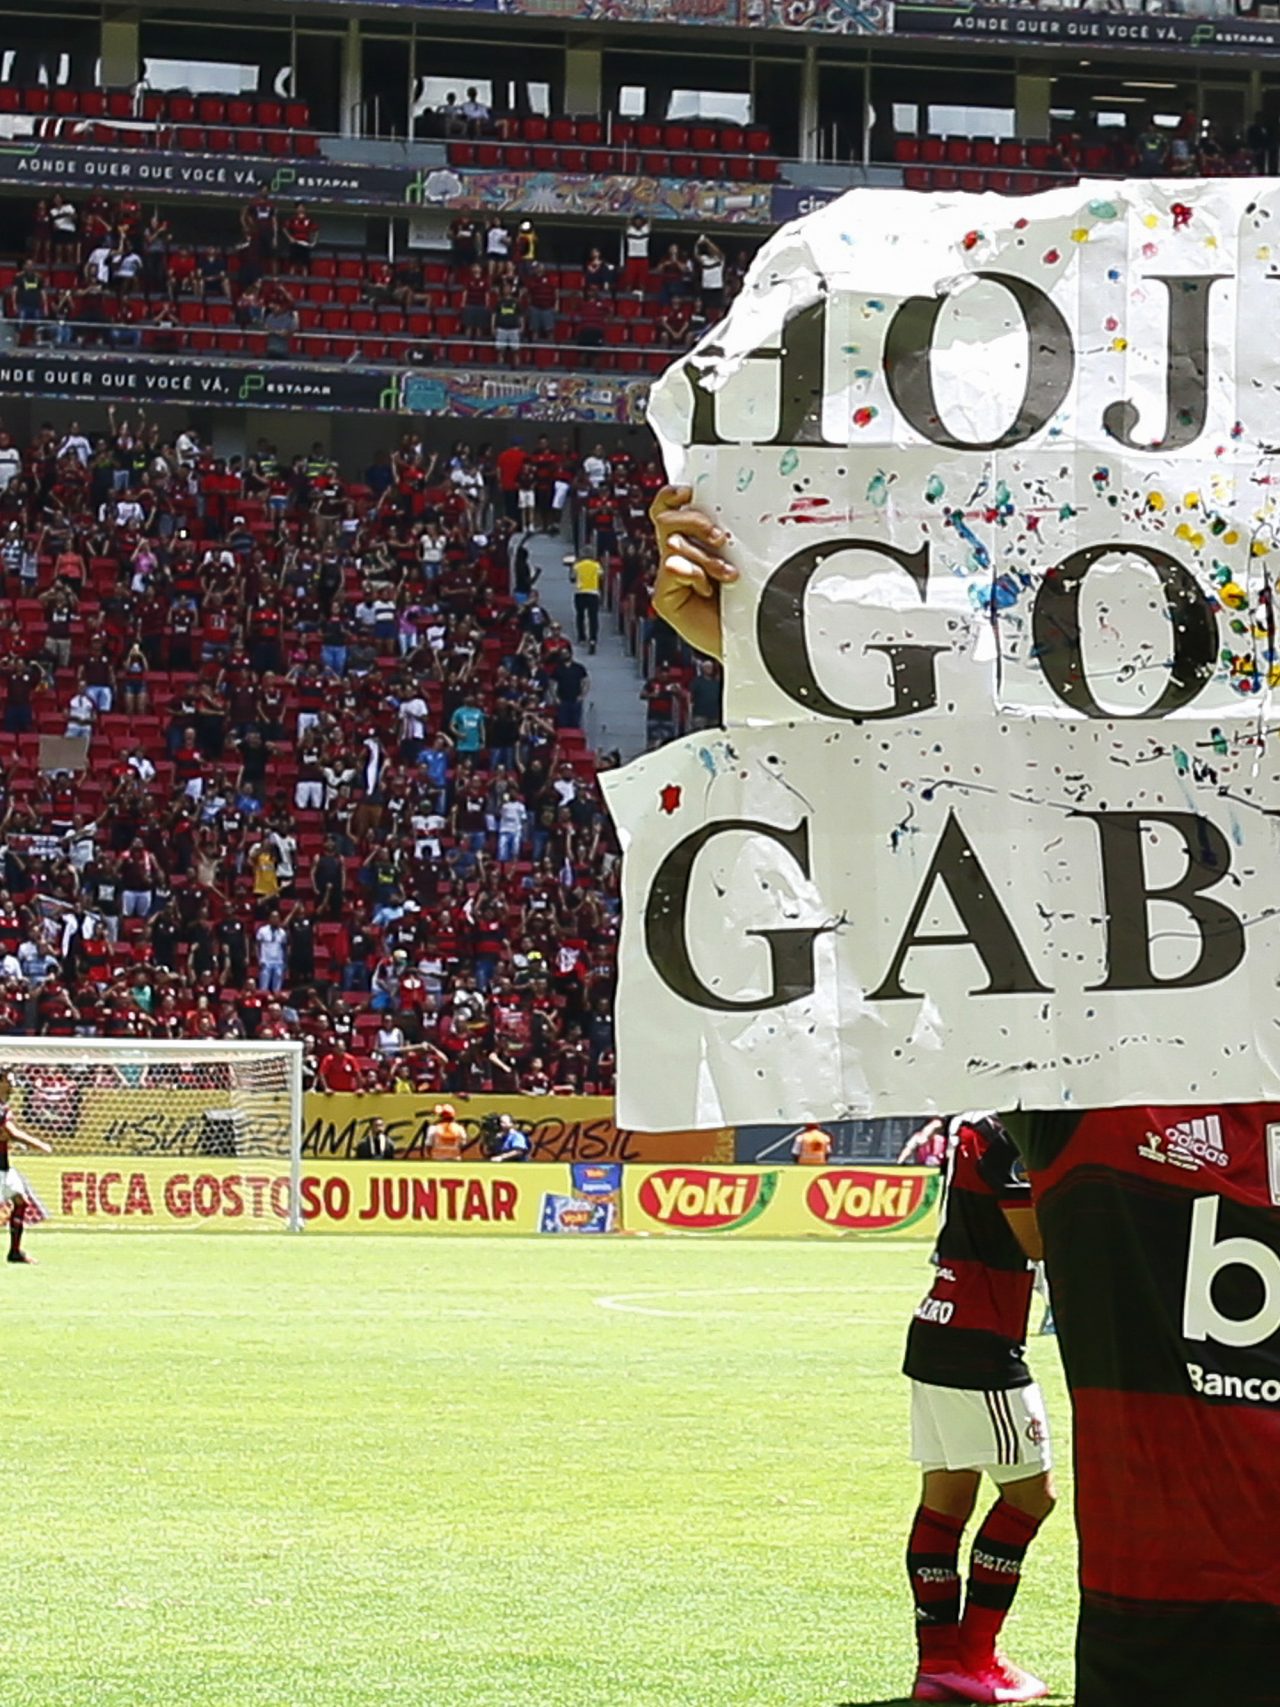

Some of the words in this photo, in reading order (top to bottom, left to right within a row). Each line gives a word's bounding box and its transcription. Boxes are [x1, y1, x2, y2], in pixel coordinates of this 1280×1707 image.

[953, 17, 1008, 31] AONDE
[1016, 20, 1060, 33] QUER
[1067, 23, 1100, 36] QUE
[1106, 24, 1150, 40] VOCÊ
[17, 158, 76, 173] AONDE
[84, 162, 131, 177] QUER
[139, 165, 174, 179] QUE
[181, 165, 226, 183] VOCÊ
[297, 176, 360, 189] ESTAPAR
[46, 371, 93, 385] QUER
[101, 374, 138, 388] QUE
[146, 374, 192, 391] VOCÊ
[266, 383, 332, 395] ESTAPAR
[1165, 1127, 1230, 1168] adidas
[60, 1171, 154, 1217] FICA
[163, 1173, 351, 1221] GOSTOSO
[358, 1176, 518, 1222] JUNTAR
[649, 1176, 749, 1220] Yoki
[816, 1177, 914, 1221] Yoki
